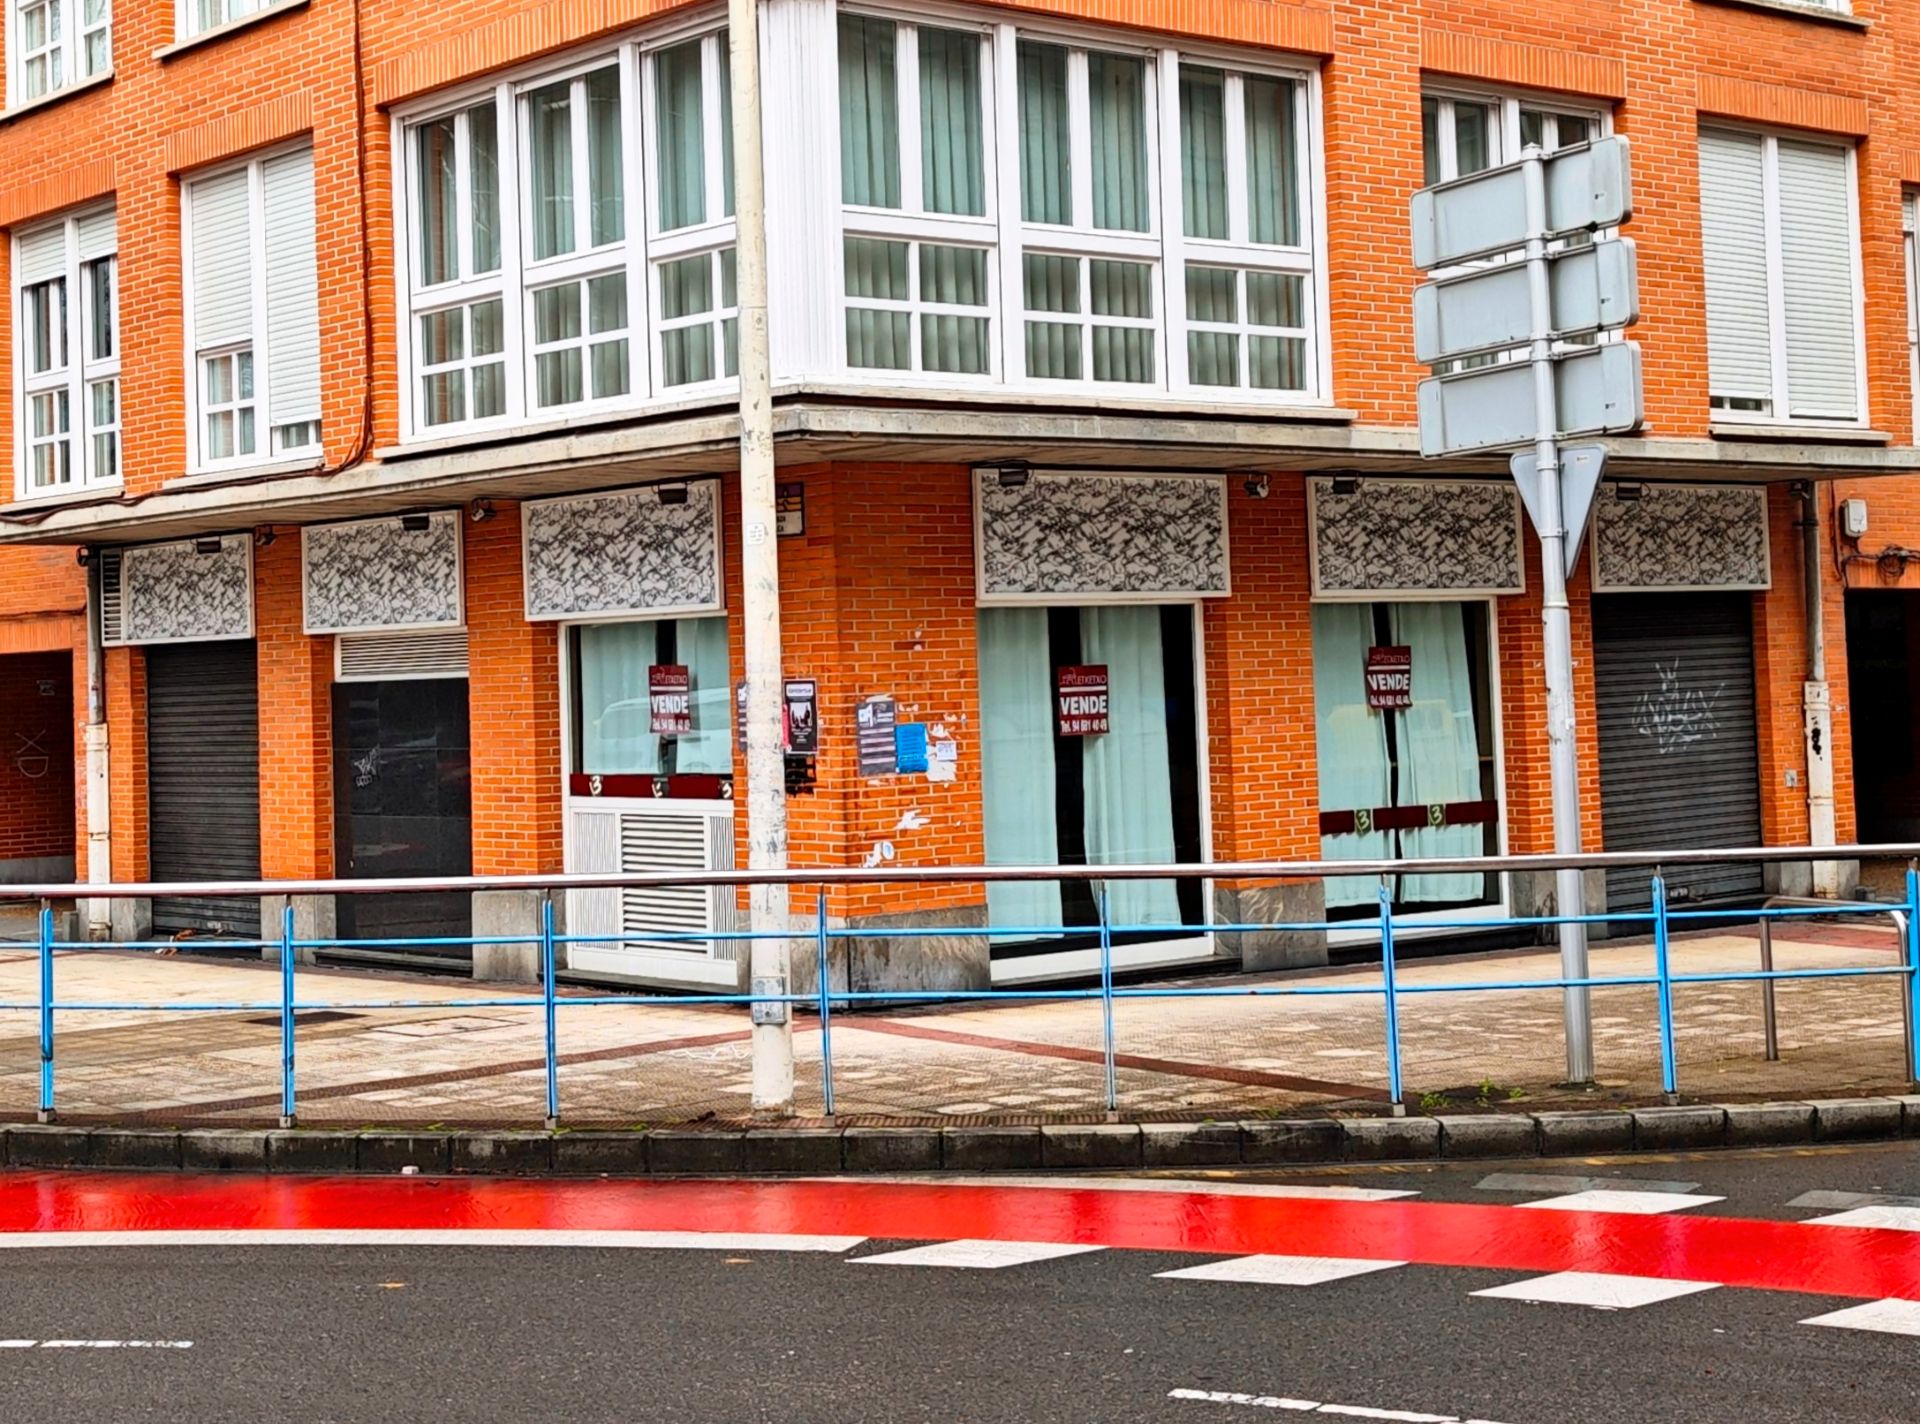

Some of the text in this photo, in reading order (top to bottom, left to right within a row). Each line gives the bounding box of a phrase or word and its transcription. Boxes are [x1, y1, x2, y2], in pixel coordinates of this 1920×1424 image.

[1367, 674, 1410, 691] VENDE
[651, 695, 689, 714] VENDE
[1060, 695, 1107, 715] VENDE
